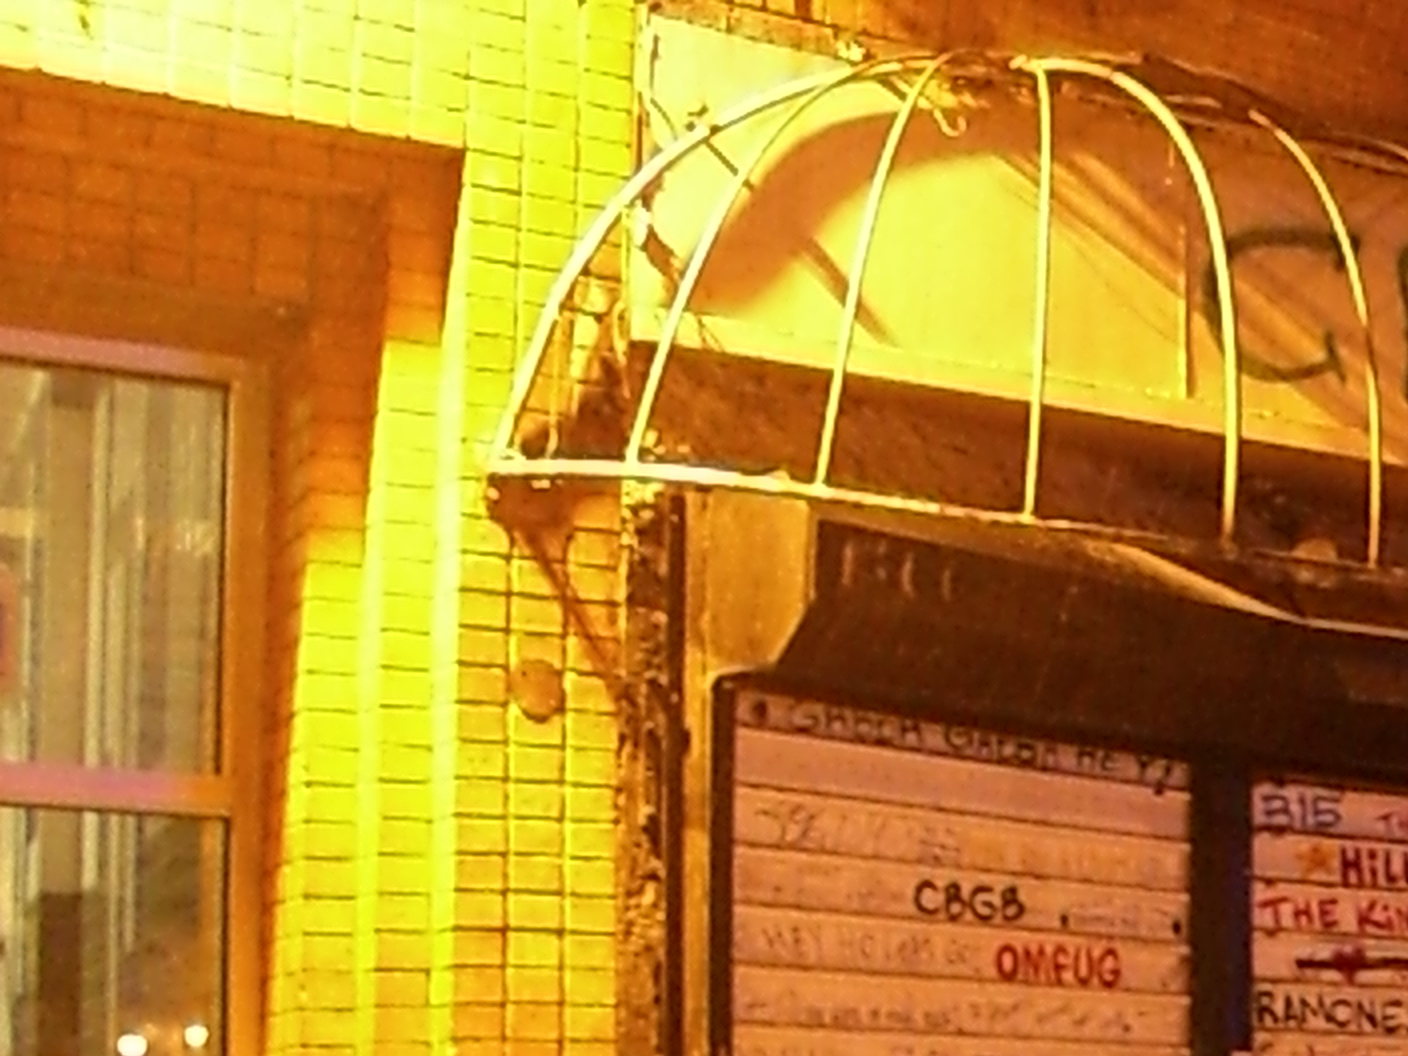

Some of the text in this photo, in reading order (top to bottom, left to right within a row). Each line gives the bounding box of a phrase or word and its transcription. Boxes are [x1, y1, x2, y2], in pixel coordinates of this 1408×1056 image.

[913, 878, 1026, 922] CBGB
[1260, 898, 1338, 931] THE
[995, 943, 1121, 989] OMFUG
